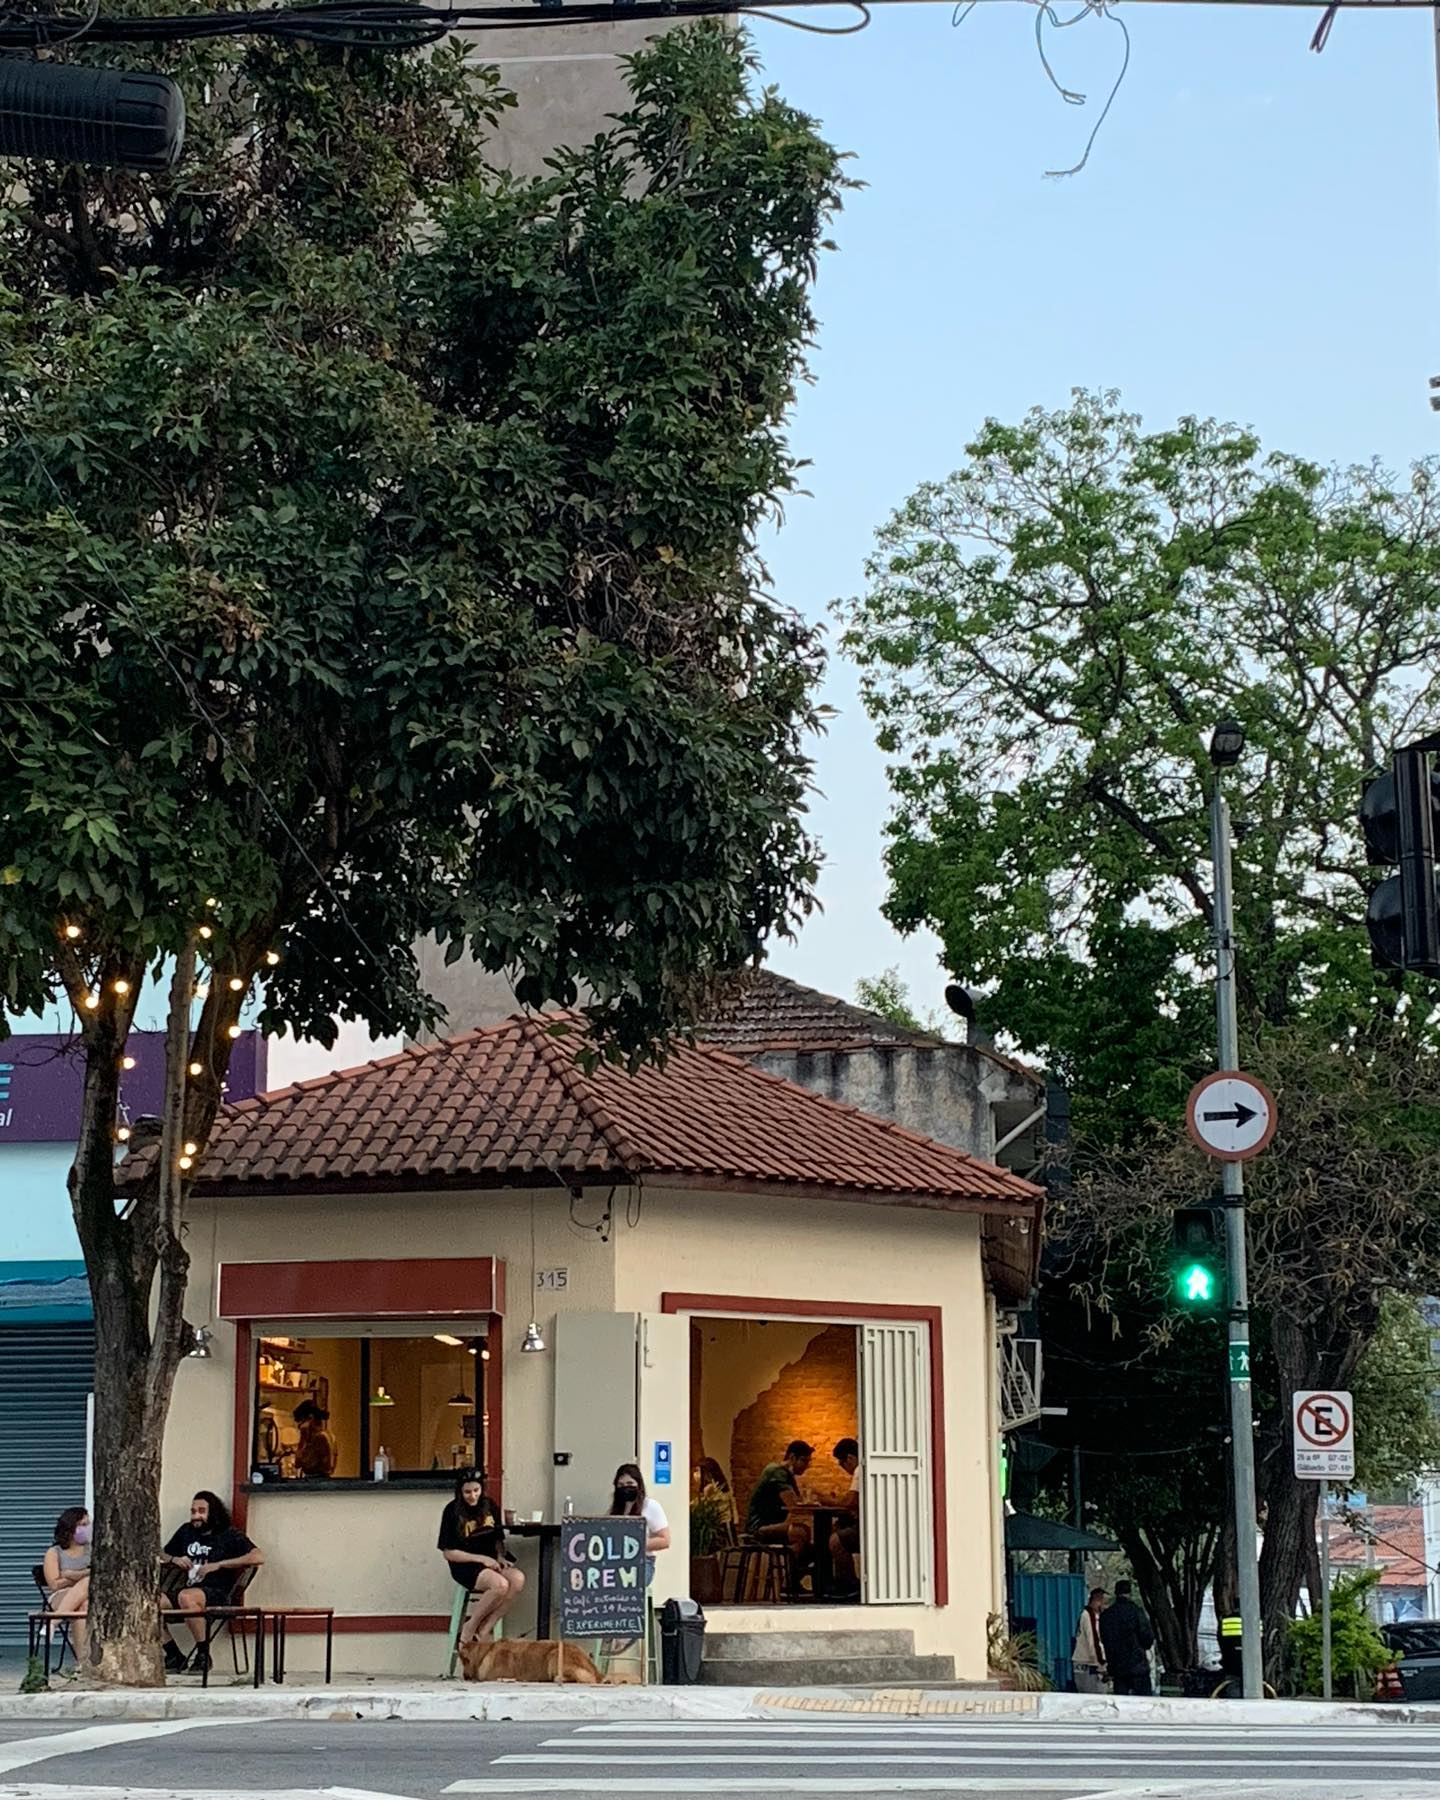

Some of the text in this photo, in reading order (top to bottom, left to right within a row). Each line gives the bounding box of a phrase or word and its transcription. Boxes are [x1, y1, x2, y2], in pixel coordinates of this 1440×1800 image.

[536, 1271, 567, 1288] 315
[1315, 1407, 1333, 1435] E
[568, 1533, 640, 1563] COLD
[570, 1566, 638, 1591] BREW
